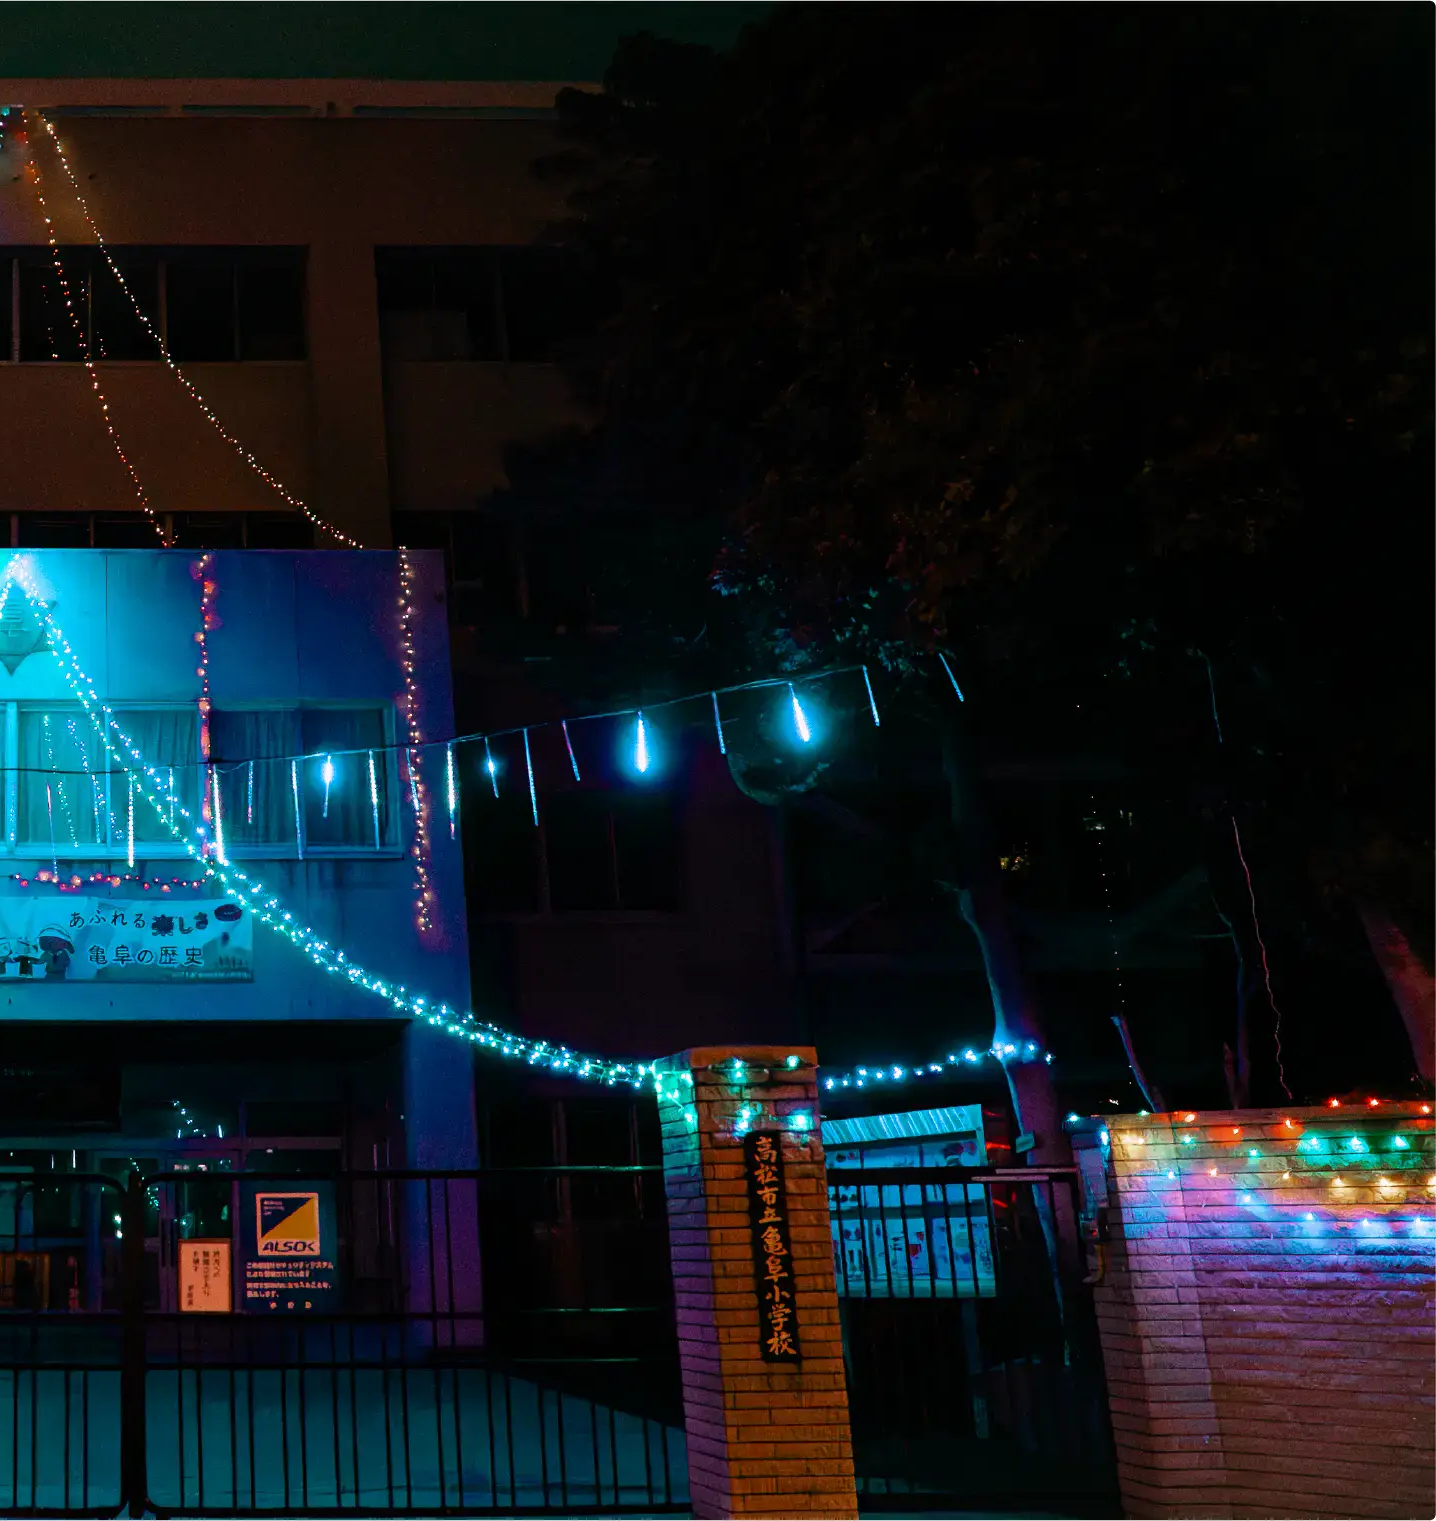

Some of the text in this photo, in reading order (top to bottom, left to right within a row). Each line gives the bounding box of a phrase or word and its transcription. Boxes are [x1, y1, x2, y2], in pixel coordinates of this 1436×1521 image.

[69, 905, 210, 937] あふれる楽しさ
[89, 944, 204, 966] 亀阜の歴史
[262, 1240, 315, 1253] ALSOK
[753, 1135, 797, 1356] 高松市立亀阜小学校
